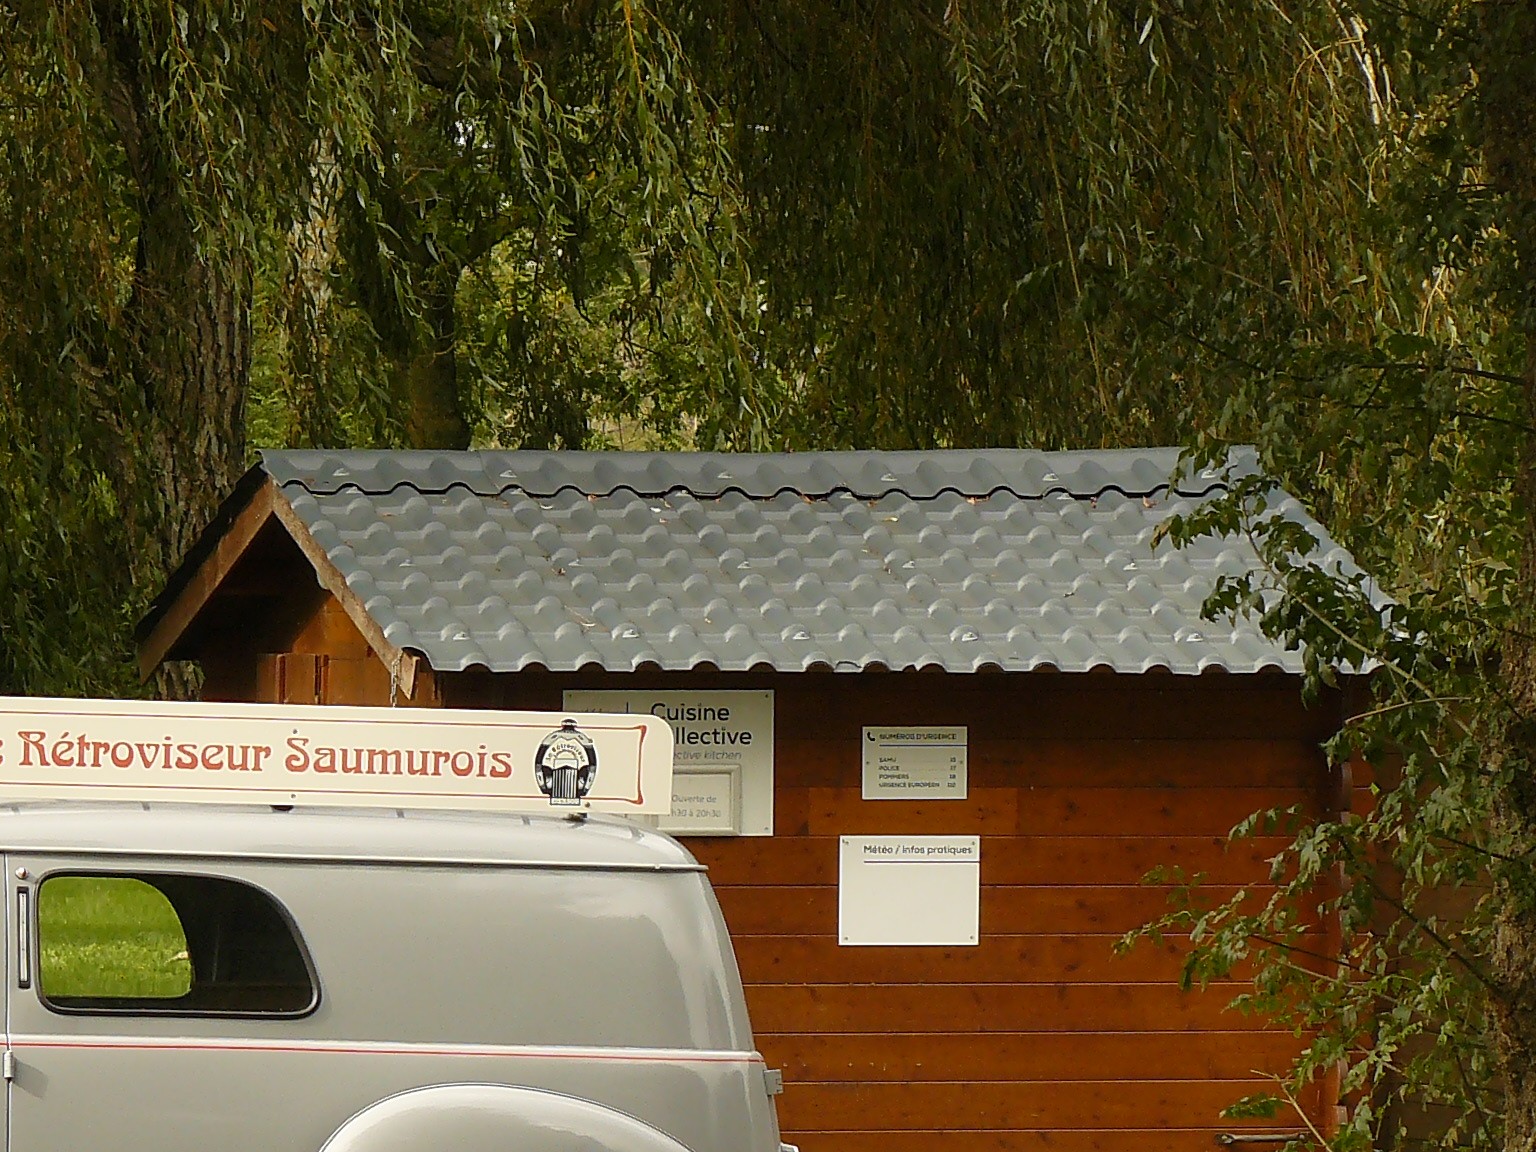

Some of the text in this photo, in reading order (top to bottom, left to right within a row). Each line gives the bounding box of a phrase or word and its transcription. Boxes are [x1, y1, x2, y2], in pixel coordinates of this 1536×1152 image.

[650, 702, 730, 721] Cuisine
[675, 726, 752, 745] llective
[17, 731, 272, 772] Rétroviseur
[284, 737, 513, 779] Saumurois
[704, 750, 742, 761] kitchen
[671, 794, 717, 803] Ouverte de
[863, 845, 893, 854] Météo
[902, 845, 925, 854] Infos
[927, 845, 972, 856] pratiques
